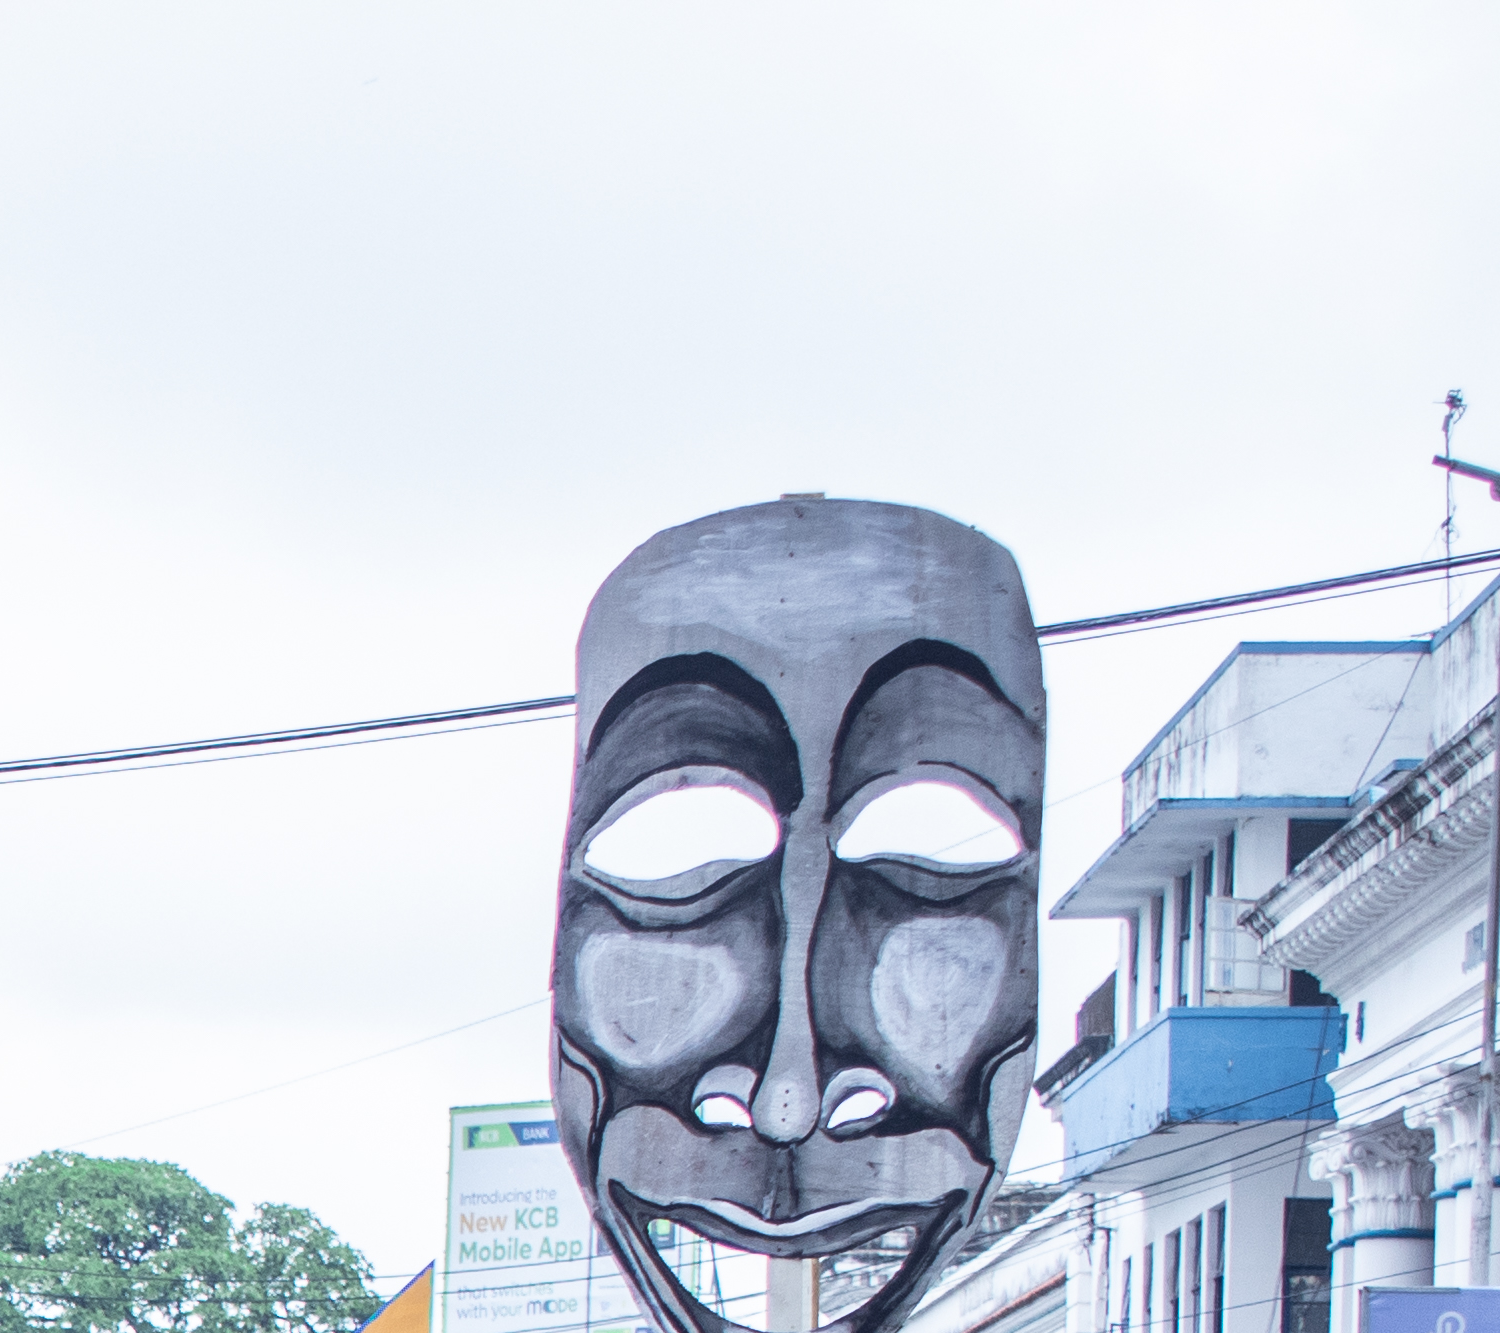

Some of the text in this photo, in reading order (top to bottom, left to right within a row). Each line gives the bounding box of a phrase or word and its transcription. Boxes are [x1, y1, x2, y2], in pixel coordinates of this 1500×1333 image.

[479, 1127, 550, 1142] KCB BANK
[460, 1188, 557, 1207] Introducing the
[460, 1207, 559, 1234] New KCB
[459, 1237, 583, 1264] Mobile App
[457, 1283, 554, 1301] that switches
[457, 1303, 523, 1321] with your
